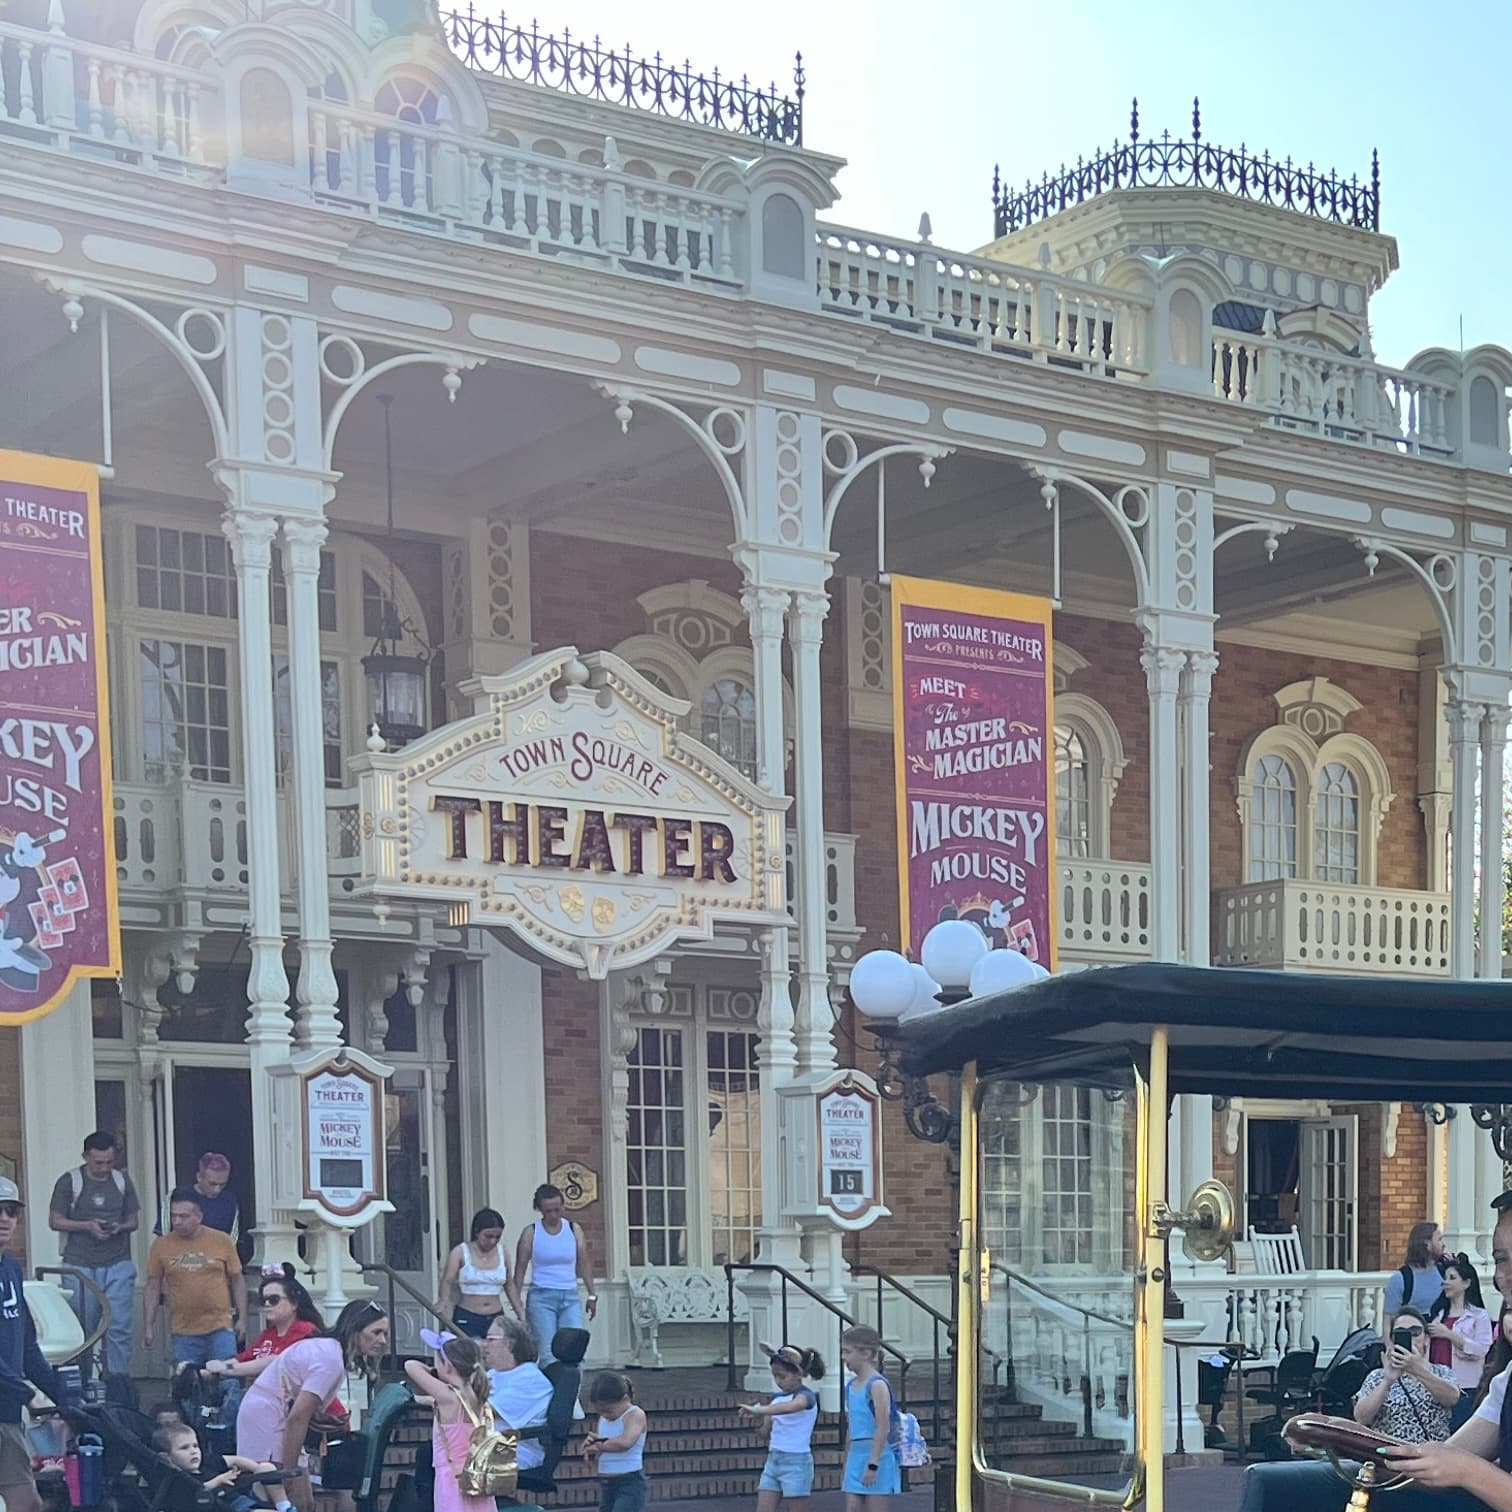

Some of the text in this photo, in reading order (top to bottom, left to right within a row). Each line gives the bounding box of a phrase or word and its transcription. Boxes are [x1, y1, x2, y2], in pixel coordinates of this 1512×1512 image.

[4, 497, 85, 539] THEATER
[904, 622, 1043, 662] TOWN SQUARE THEATER
[955, 645, 995, 660] PRESENTS
[920, 677, 966, 699] MEET
[934, 703, 958, 725] The
[925, 718, 1007, 751] MASTER
[499, 731, 668, 796] TOWN SQUARE
[933, 737, 1042, 780] MAGICIAN
[431, 795, 738, 884] THEATER
[911, 800, 1045, 867] MICKEY
[930, 852, 1027, 895] MOUSE
[315, 1090, 365, 1102] THEATER
[826, 1109, 864, 1120] THEATER
[320, 1123, 362, 1136] MICKEY
[320, 1135, 362, 1149] MOUSE
[830, 1148, 862, 1161] MOUSE
[838, 1174, 855, 1191] 15
